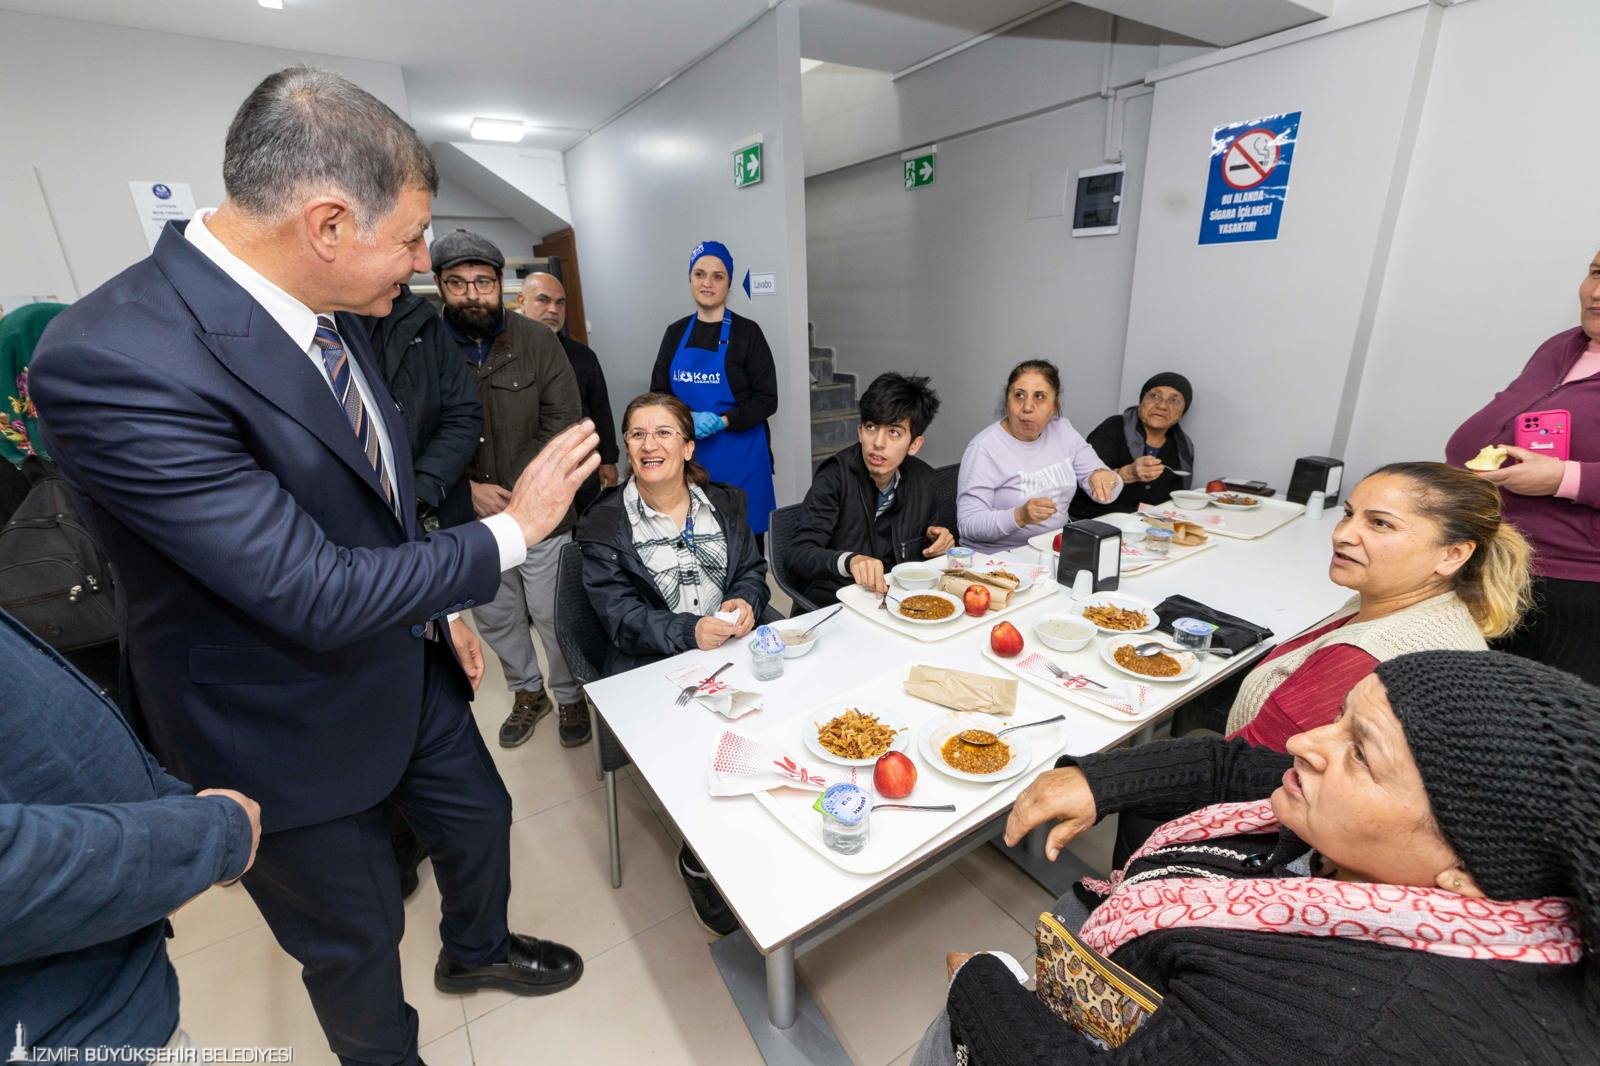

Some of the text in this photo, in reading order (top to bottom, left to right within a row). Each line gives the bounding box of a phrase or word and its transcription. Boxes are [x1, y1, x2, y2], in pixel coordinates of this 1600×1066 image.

[1221, 190, 1265, 205] BU ALANDA
[1209, 202, 1273, 221] SİGARA İÇİLMESİ
[1219, 221, 1257, 235] YASAKTIR!
[754, 280, 772, 288] Lavabo
[693, 371, 720, 380] Kent
